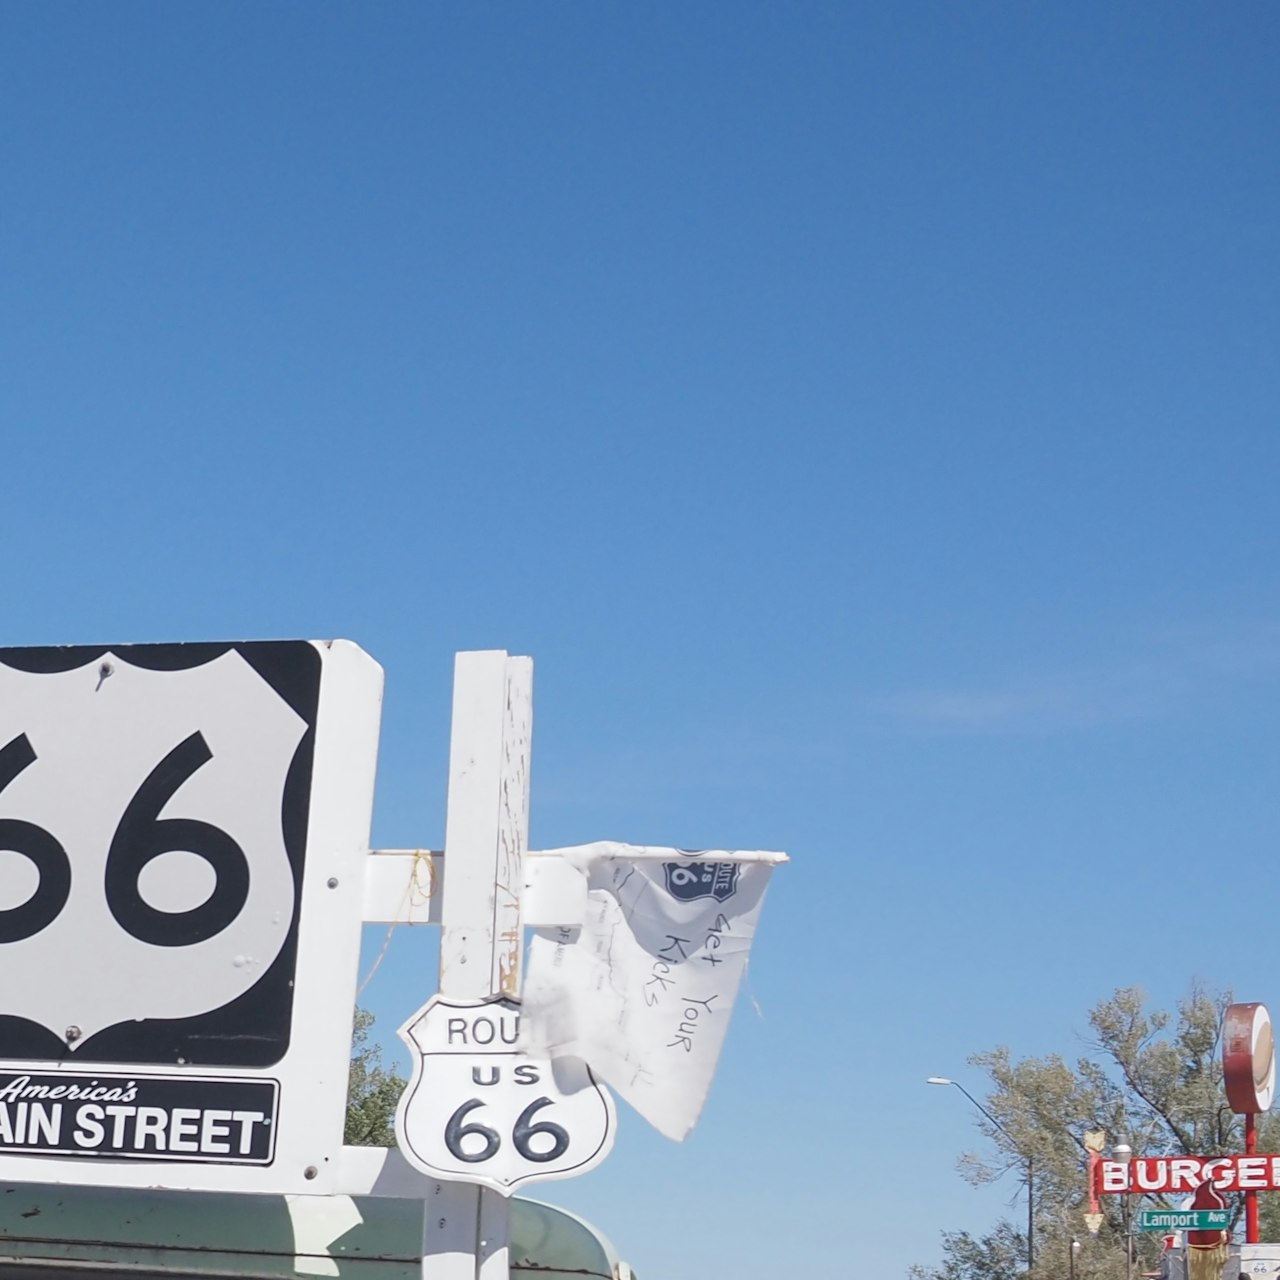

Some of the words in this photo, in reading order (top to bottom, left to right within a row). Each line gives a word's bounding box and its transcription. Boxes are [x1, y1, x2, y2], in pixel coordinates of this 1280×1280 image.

[448, 1016, 520, 1044] ROU
[73, 1105, 265, 1155] STREET
[444, 1096, 570, 1163] 66
[1102, 1157, 1280, 1191] BURGE
[1143, 1212, 1199, 1228] Lamport
[1208, 1212, 1226, 1223] Ave
